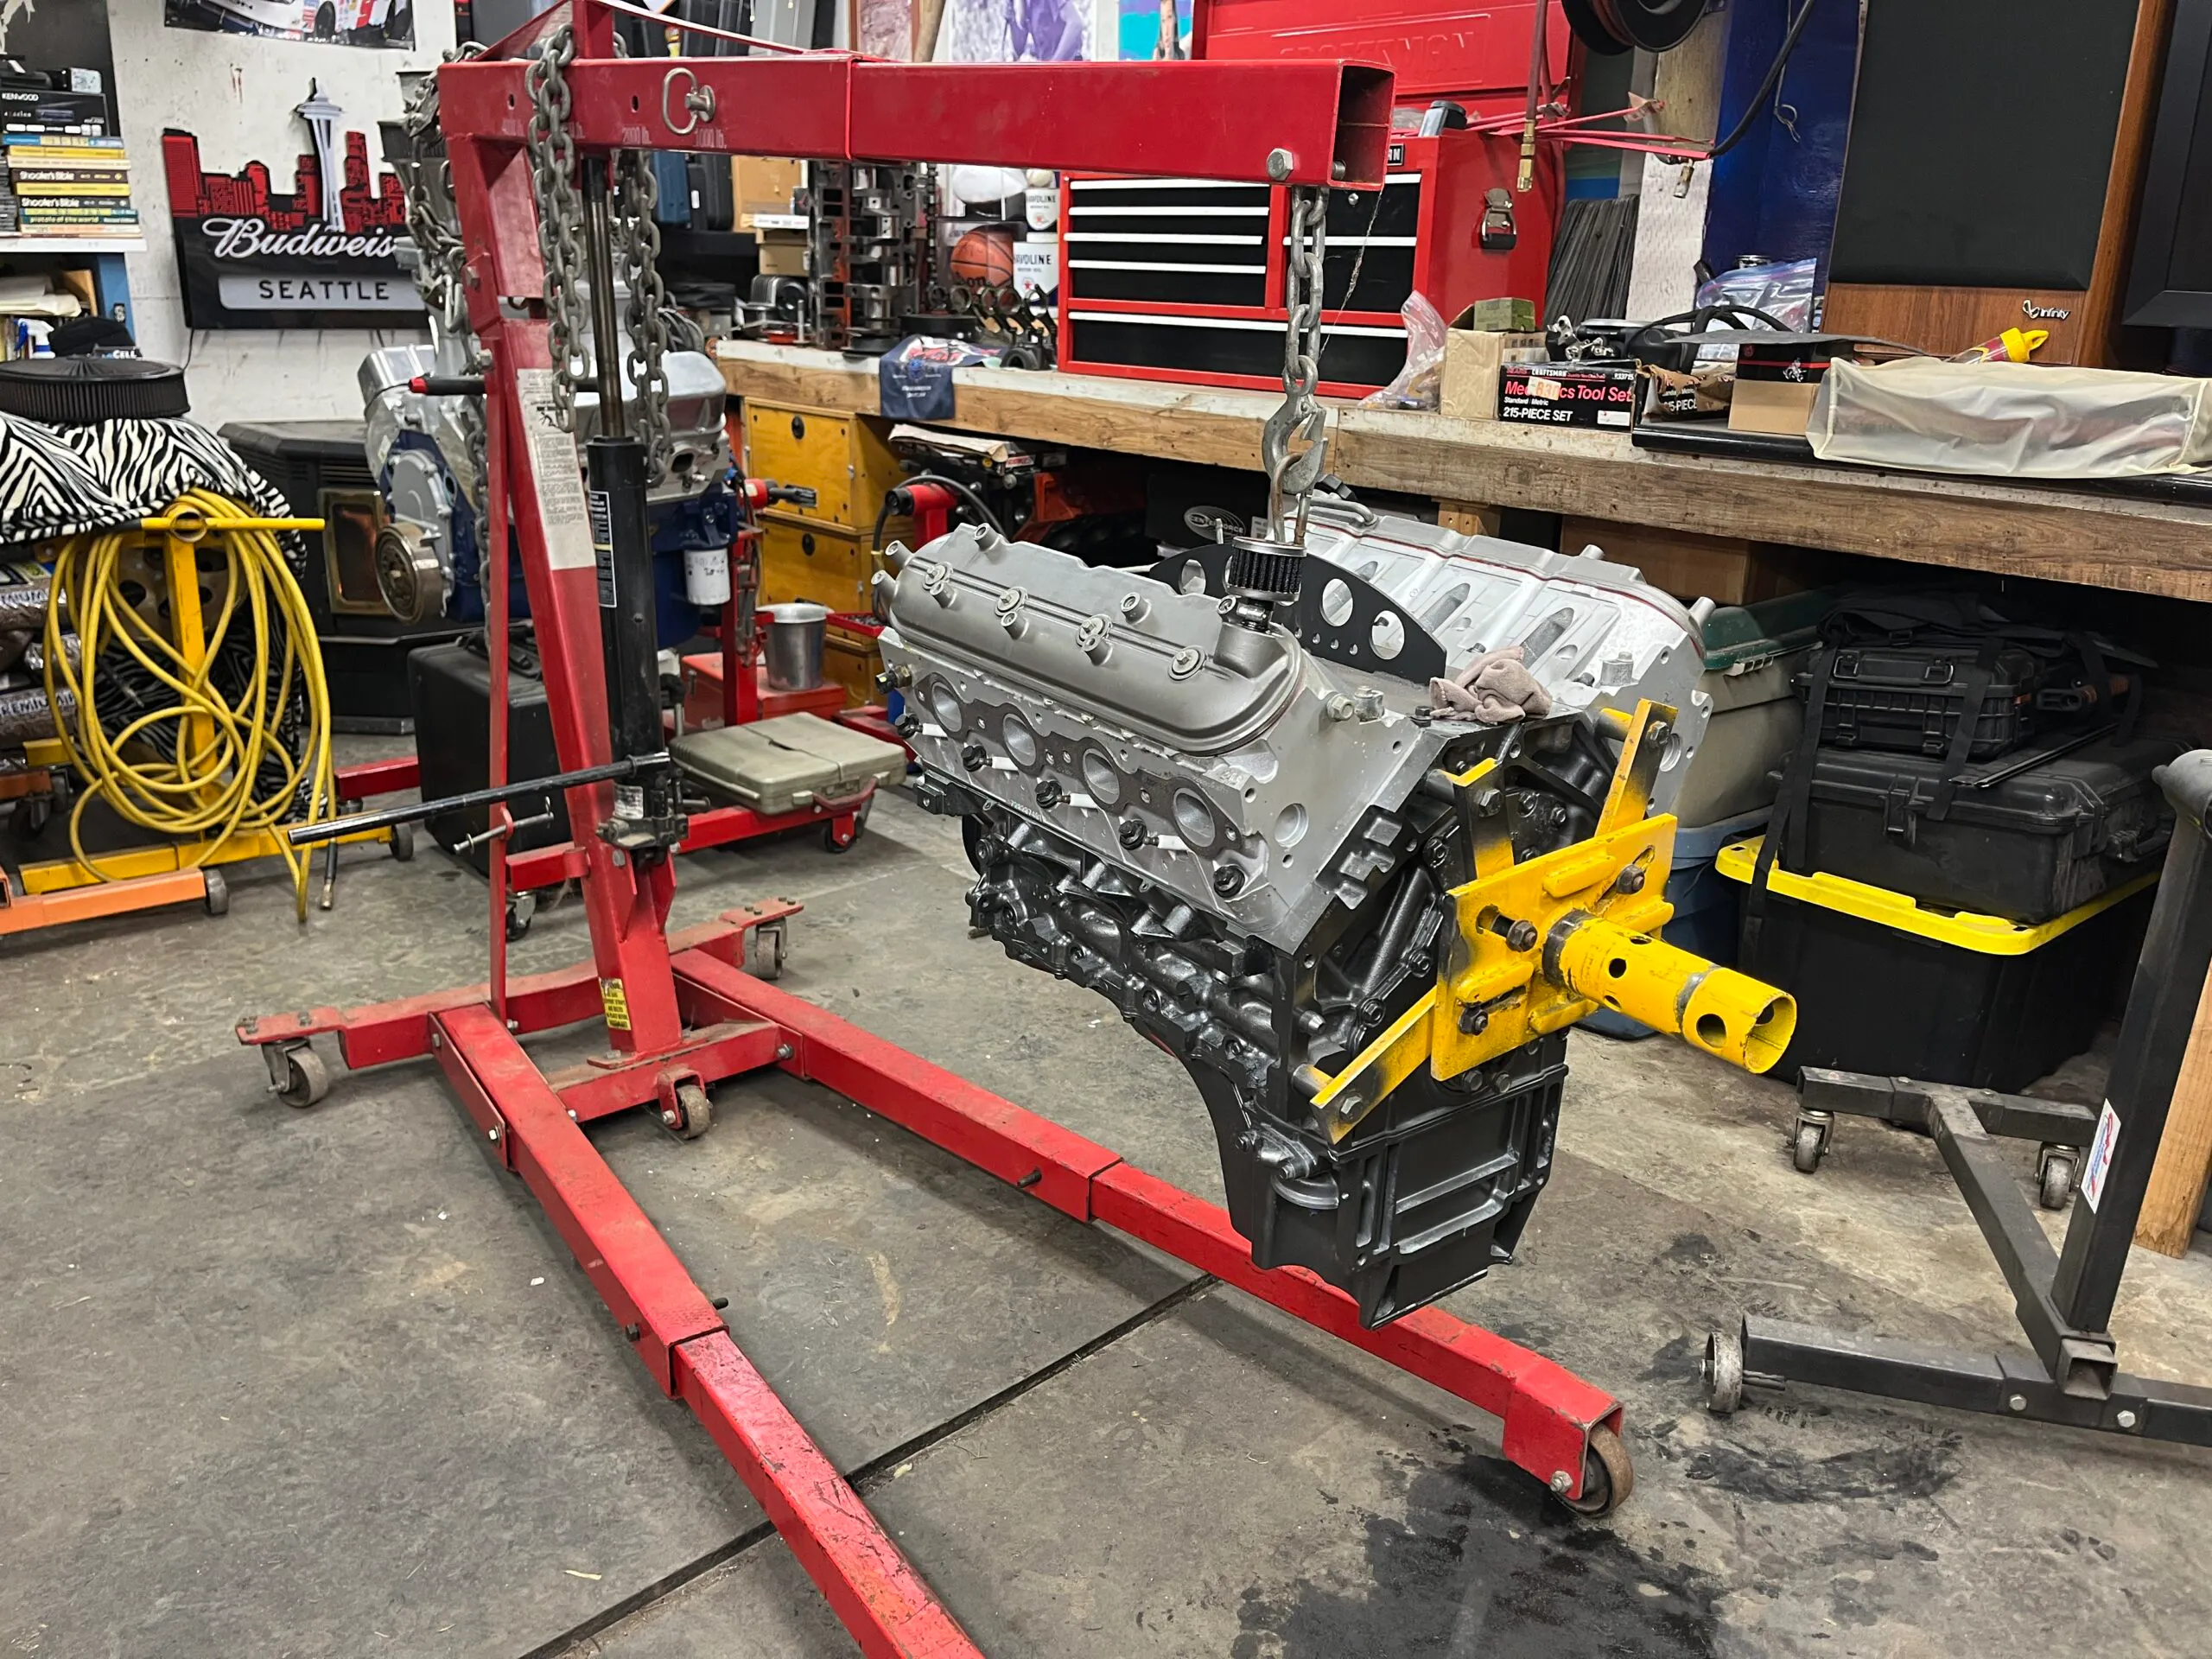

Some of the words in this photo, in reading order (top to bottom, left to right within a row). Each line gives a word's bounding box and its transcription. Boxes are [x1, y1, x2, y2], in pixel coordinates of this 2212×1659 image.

[2, 92, 39, 101] KENWOOD
[259, 280, 390, 300] SEATTLE
[1532, 368, 1568, 378] CRAFTSMAN
[1578, 385, 1606, 401] Tool
[1608, 387, 1634, 403] Set
[1503, 407, 1552, 421] 215-PIECE
[1552, 410, 1573, 422] SET
[1191, 514, 1244, 534] CENTEORCE
